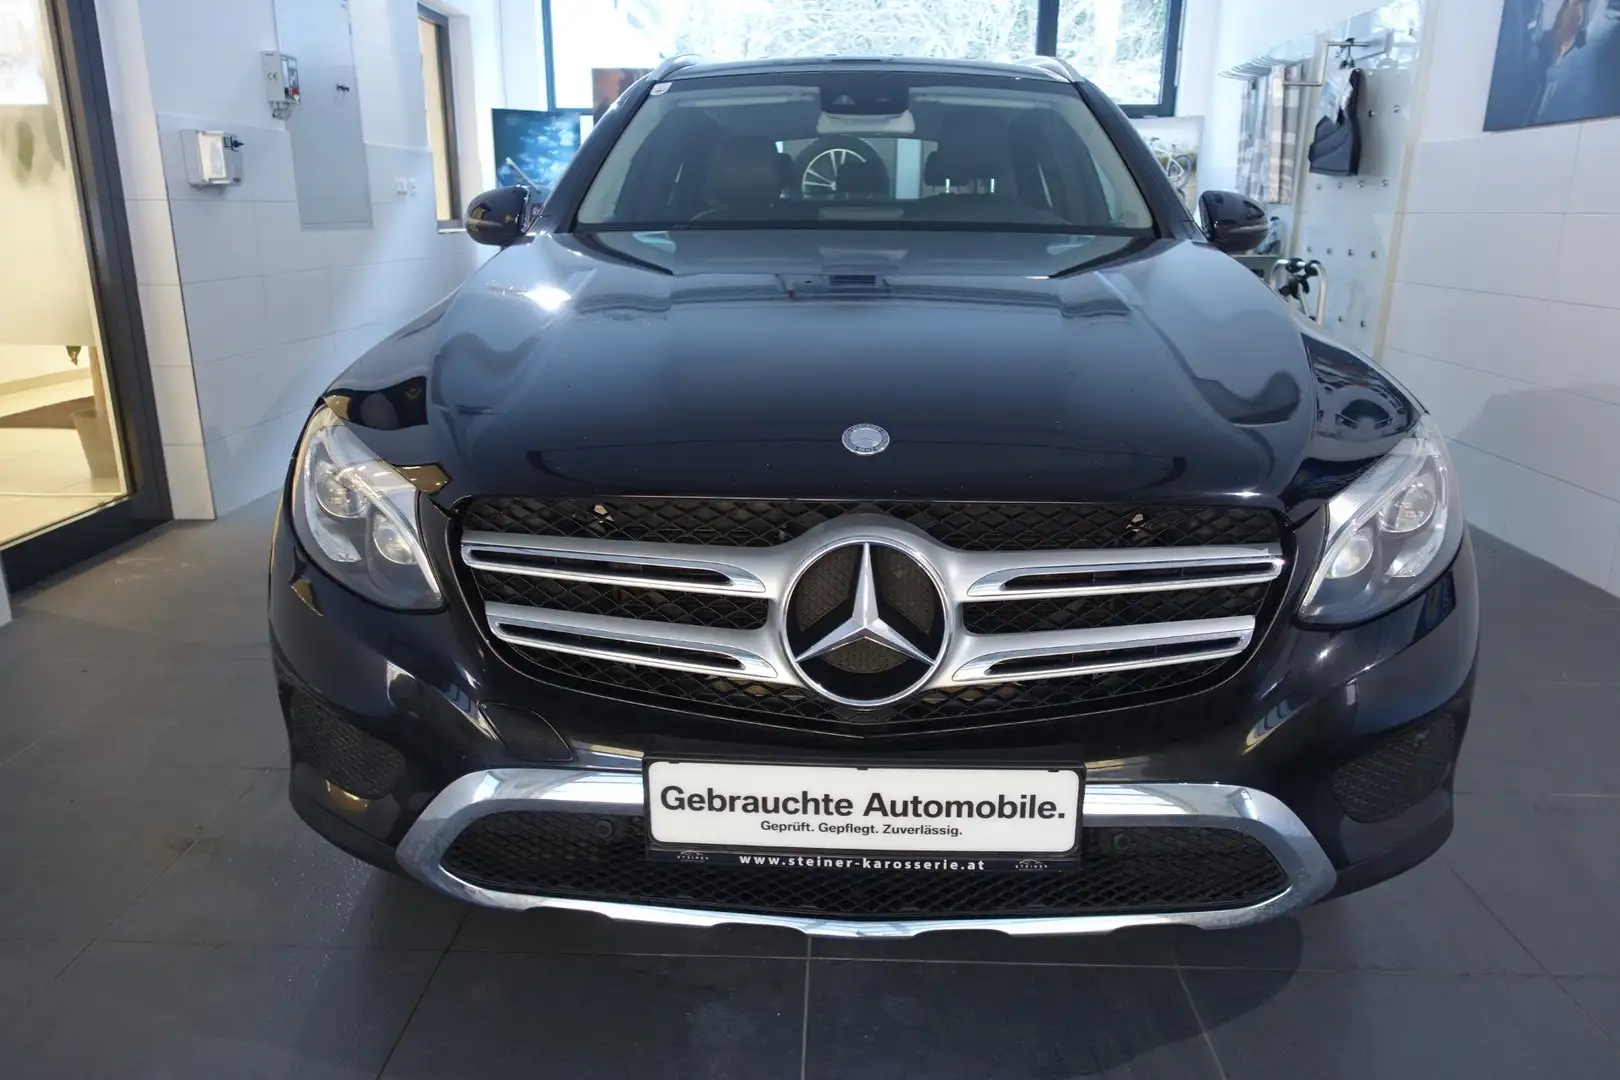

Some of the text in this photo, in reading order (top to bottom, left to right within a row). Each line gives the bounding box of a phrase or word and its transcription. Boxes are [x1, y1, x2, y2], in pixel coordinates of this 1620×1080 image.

[660, 785, 1066, 819] Gebrauchte Automobile.
[760, 820, 963, 838] Geprüft. Gepflegt. Zuverlässig.
[739, 855, 985, 871] www.steiner-karosserie.at
